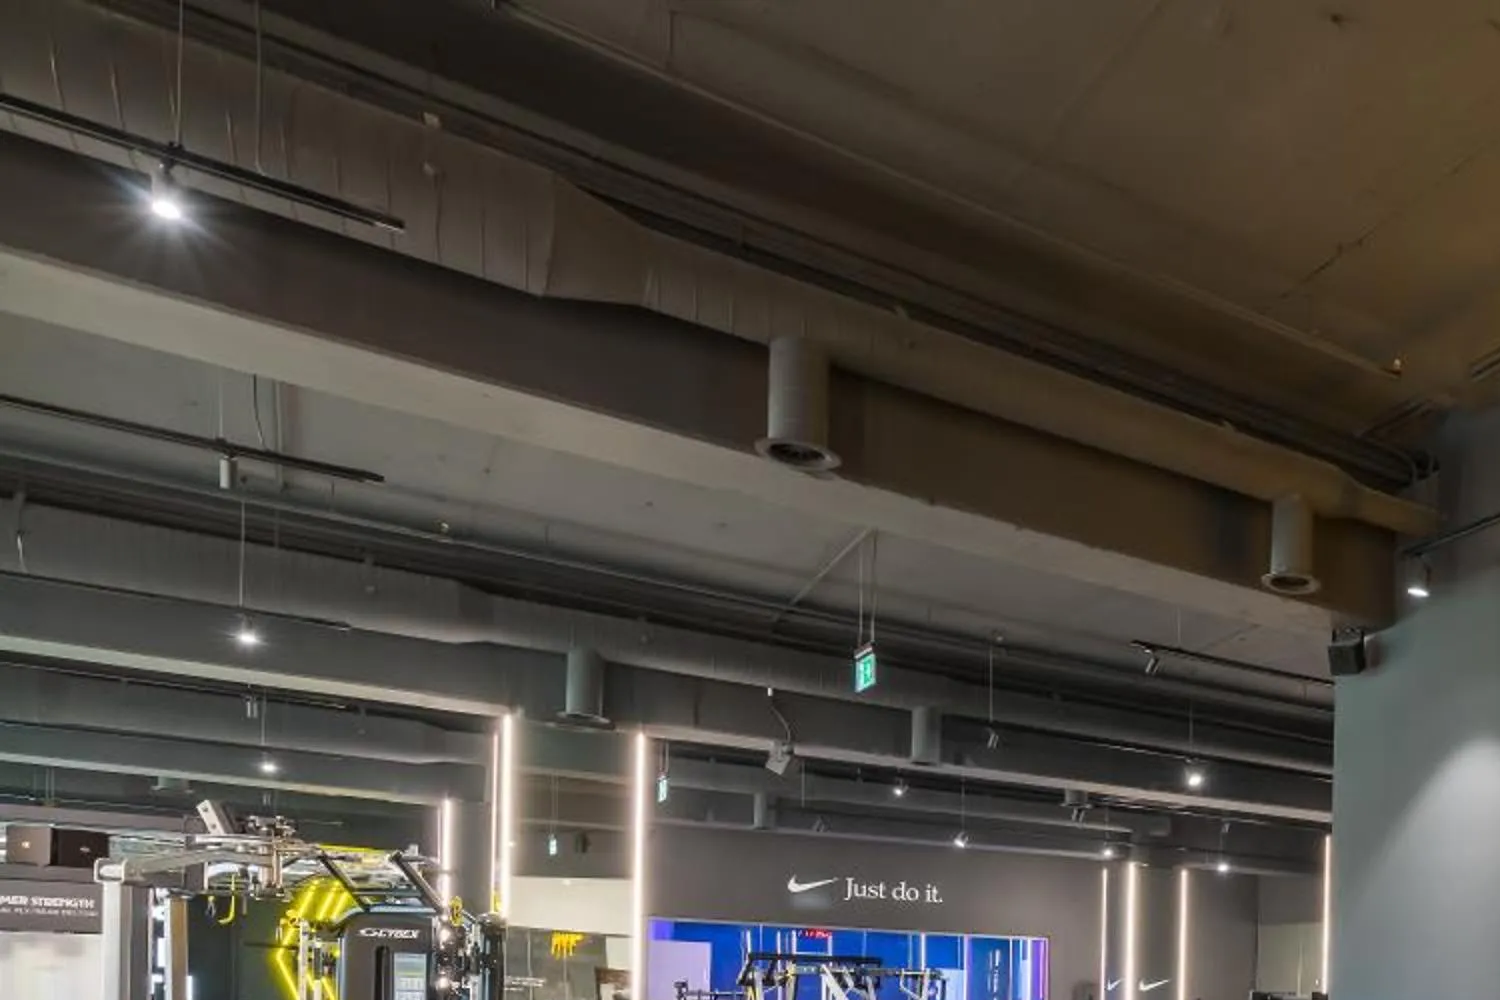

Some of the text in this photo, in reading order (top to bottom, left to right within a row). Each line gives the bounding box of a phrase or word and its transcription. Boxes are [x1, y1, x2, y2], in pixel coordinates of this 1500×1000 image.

[844, 876, 944, 904] Just do it.
[30, 896, 96, 910] STRENGTH
